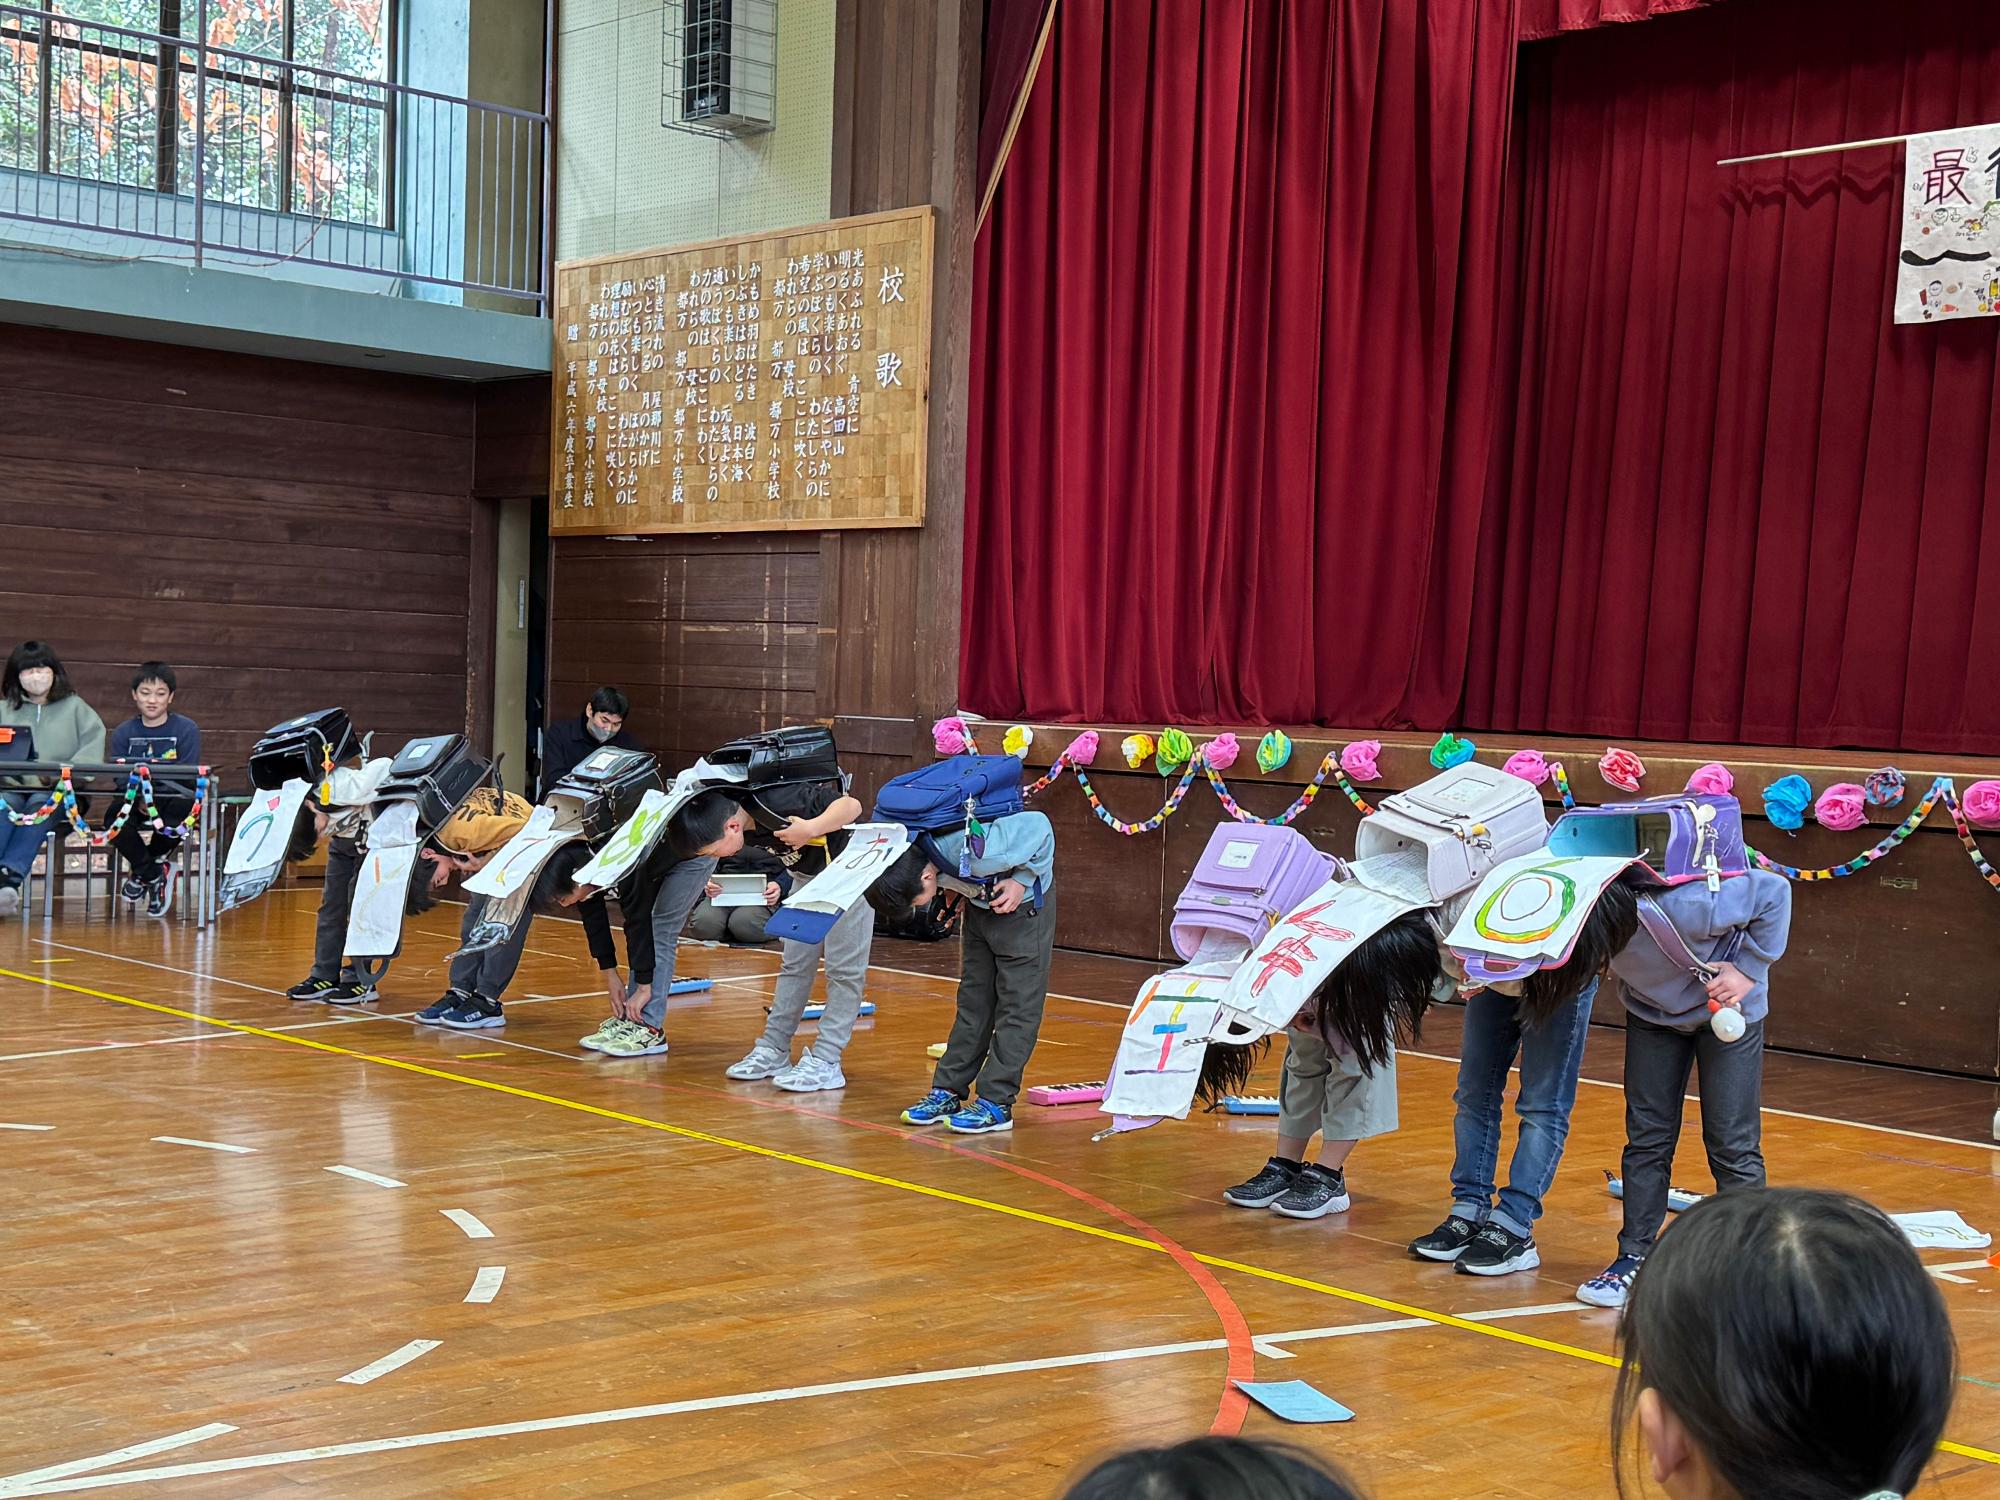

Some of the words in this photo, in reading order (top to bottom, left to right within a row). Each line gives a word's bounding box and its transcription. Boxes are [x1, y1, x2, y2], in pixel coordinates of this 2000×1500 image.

[588, 301, 600, 339] 都万
[597, 281, 612, 357] われらの
[630, 279, 644, 391] いつも楽しく
[677, 291, 688, 328] 都万
[688, 269, 702, 345] われらの
[699, 269, 714, 347] 力の歌は
[710, 267, 725, 383] 通うぼくらの
[722, 267, 736, 382] いつも楽しく
[735, 262, 749, 401] しぶきはおどる
[747, 260, 760, 400] かもめ羽ばたき
[774, 277, 785, 317] 都万
[785, 258, 800, 336] われらの
[797, 255, 812, 355] 希望の風は
[809, 253, 824, 373] 学ぶぼくらの
[824, 255, 837, 374] いつも楽しく
[836, 250, 851, 373] 明るくあおぐ
[850, 248, 864, 350] 光あふれる
[587, 360, 598, 394] 都万
[596, 376, 607, 412] 母校
[675, 350, 687, 390] 都万
[685, 366, 698, 406] 母校
[772, 340, 784, 377] 都万
[782, 360, 796, 398] 母校
[847, 374, 860, 433] 青空に
[584, 416, 596, 506] 都万小学校
[606, 396, 616, 486] ここに咲く
[616, 412, 630, 503] わたしらの
[628, 412, 641, 503] ほがらかに
[639, 392, 653, 466] 月のかげ
[672, 408, 685, 503] 都万小学校
[697, 369, 707, 463] ここにわく
[707, 406, 720, 500] わたしらの
[719, 404, 732, 482] 元気よく
[731, 425, 745, 481] 日本海
[742, 422, 756, 480] 波白く
[768, 400, 782, 499] 都万小学校
[794, 380, 806, 478] ここに吹く
[806, 398, 821, 496] わたしらの
[819, 397, 833, 496] なごやかに
[833, 396, 845, 456] 高田山
[1474, 856, 1584, 944] 6
[1250, 899, 1356, 998] 年
